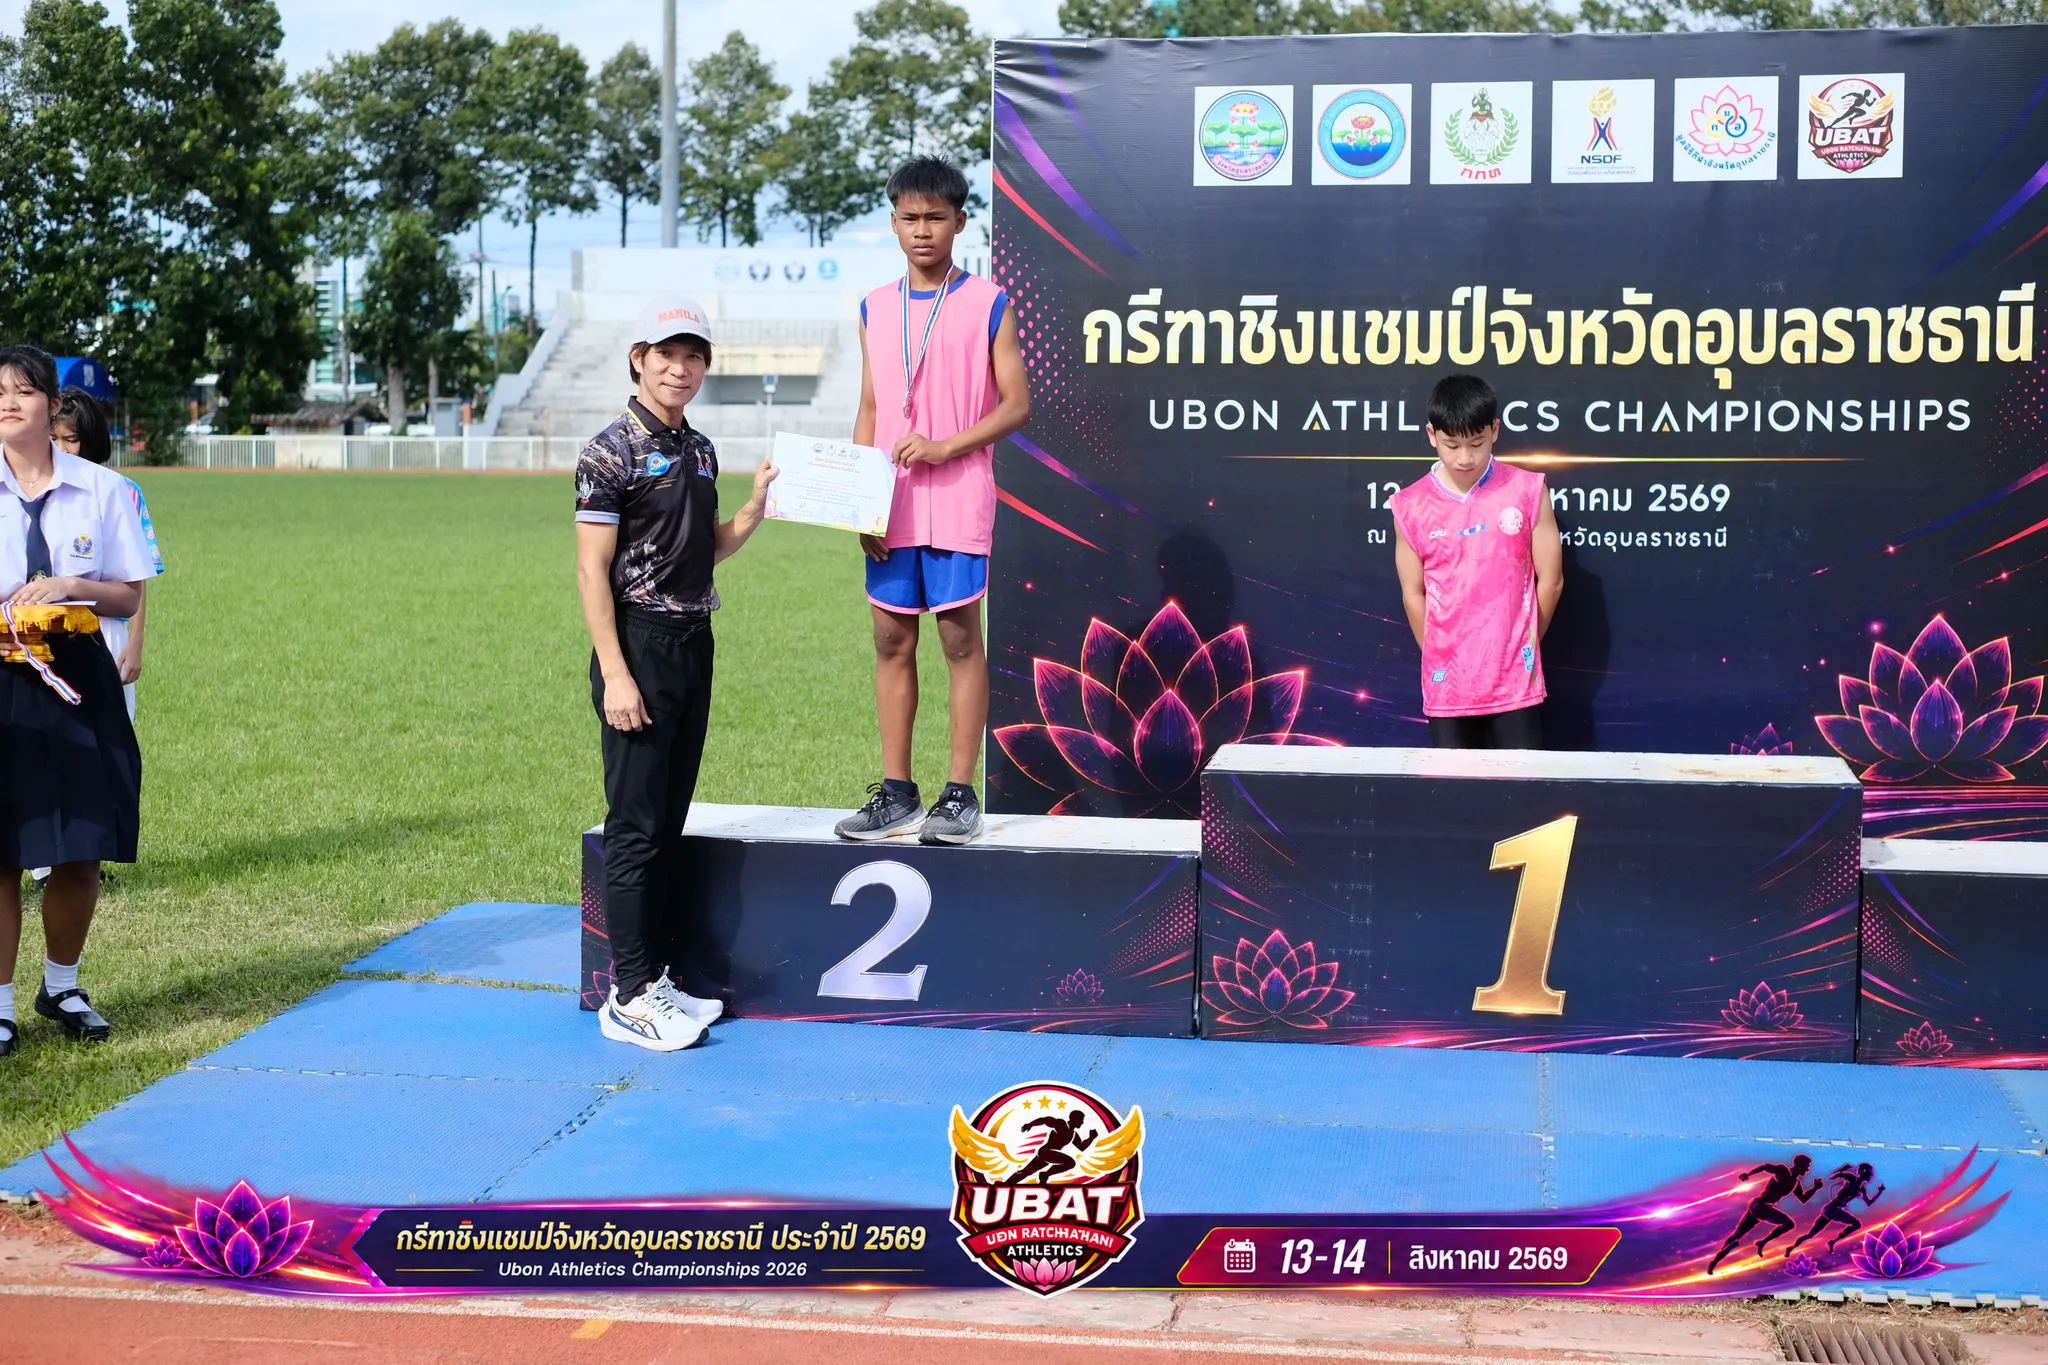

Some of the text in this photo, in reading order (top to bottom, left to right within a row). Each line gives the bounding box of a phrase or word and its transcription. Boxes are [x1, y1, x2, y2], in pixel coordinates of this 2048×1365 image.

[1815, 128, 1887, 146] UBAT
[1581, 155, 1622, 164] NSDF
[658, 309, 700, 323] MANILA
[1083, 282, 2035, 389] กรีฑาชิงแชมป์จังหวัดอุบลราชธานี
[1150, 399, 1971, 432] UBON ATHLCS CHAMPIONSHIPS
[1551, 488, 1632, 511] หาคม
[1648, 484, 1731, 512] 2569
[1367, 526, 1727, 552] ณ หวัดอุบลราชธานี
[1472, 815, 1579, 1016] 1
[817, 860, 932, 1001] 2
